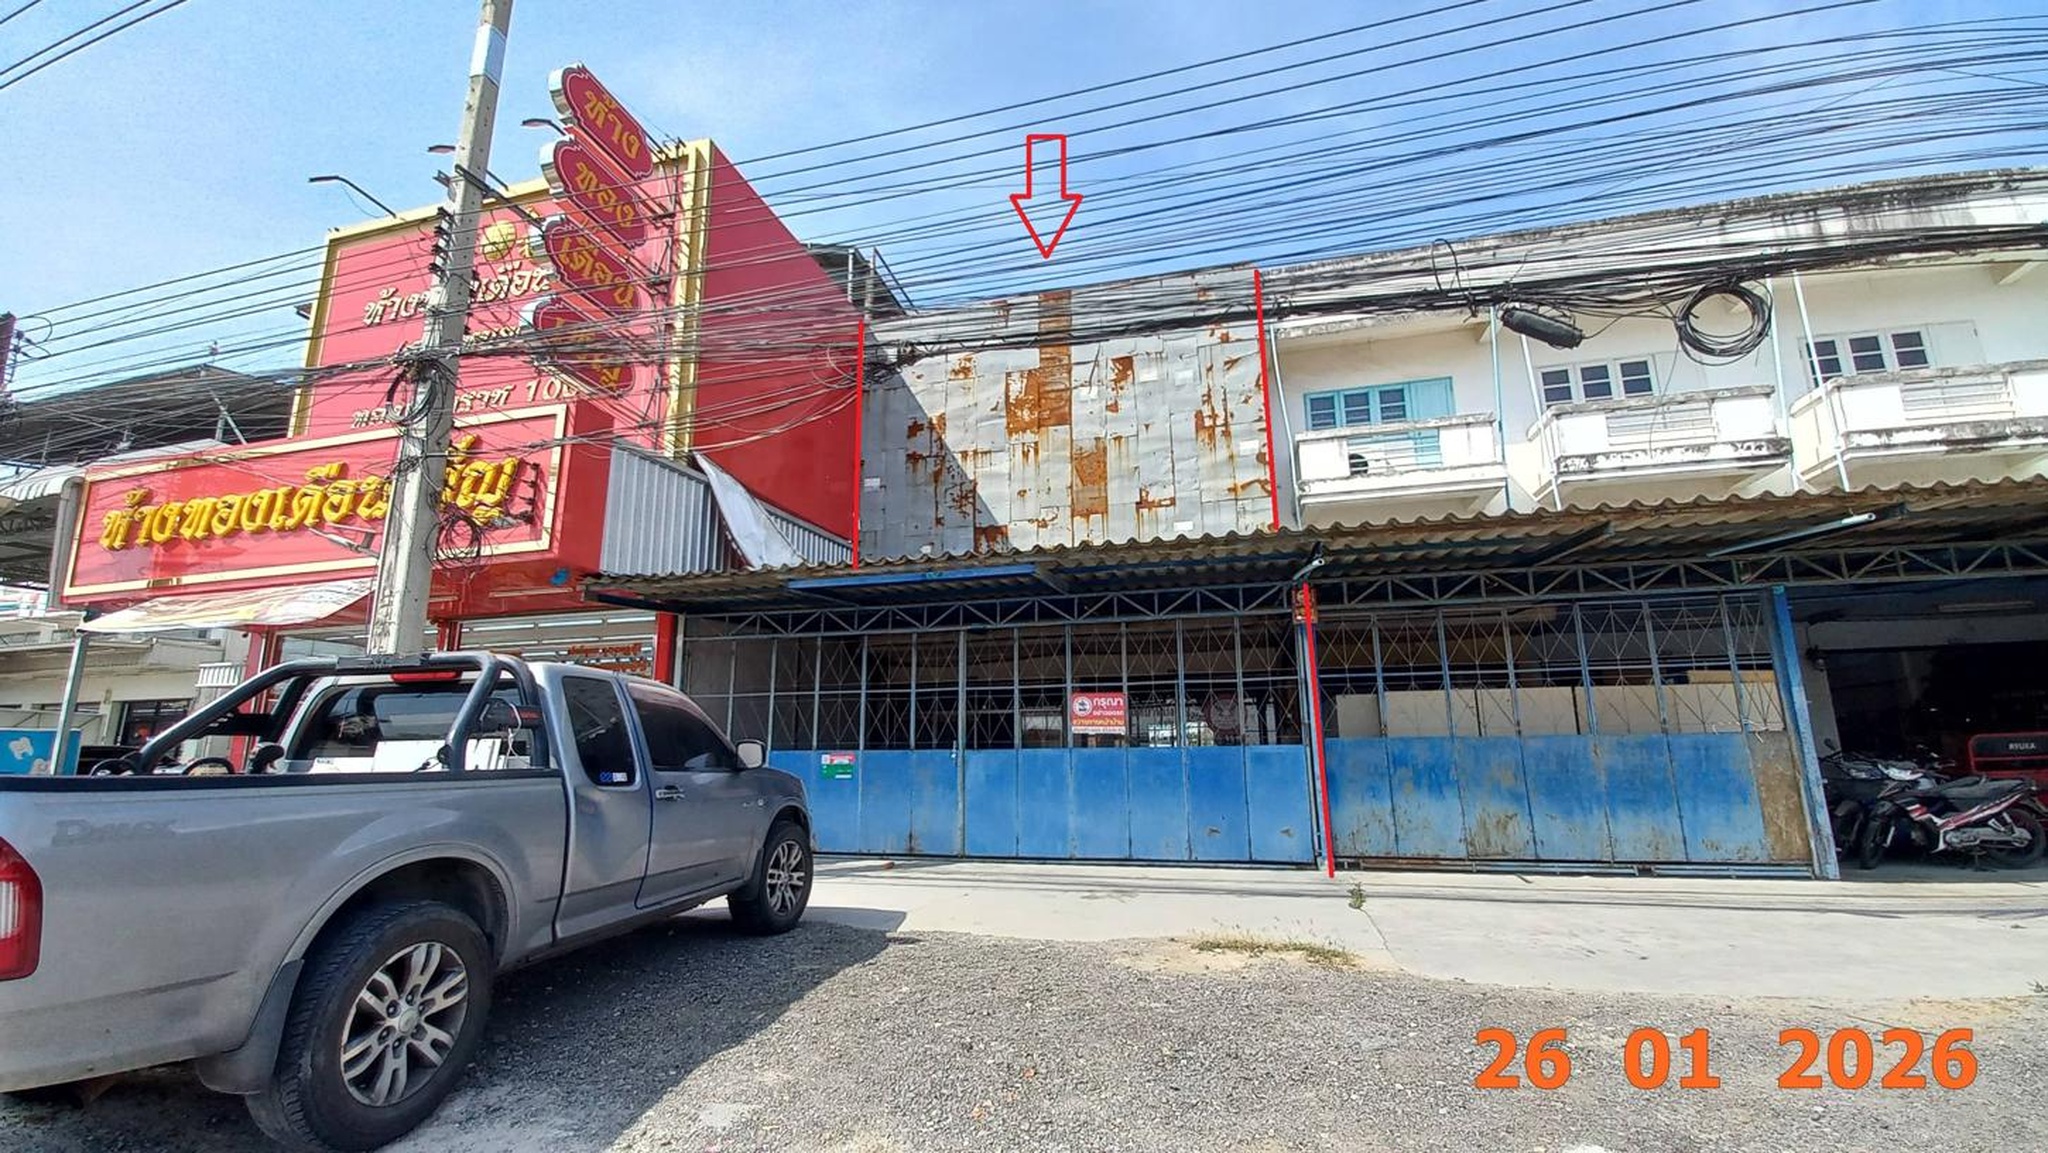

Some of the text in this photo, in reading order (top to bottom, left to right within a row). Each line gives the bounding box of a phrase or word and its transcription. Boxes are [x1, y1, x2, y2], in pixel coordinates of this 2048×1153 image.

[583, 89, 642, 160] ห้าง
[574, 162, 635, 228] ทอง
[1092, 697, 1124, 710] กรุณา
